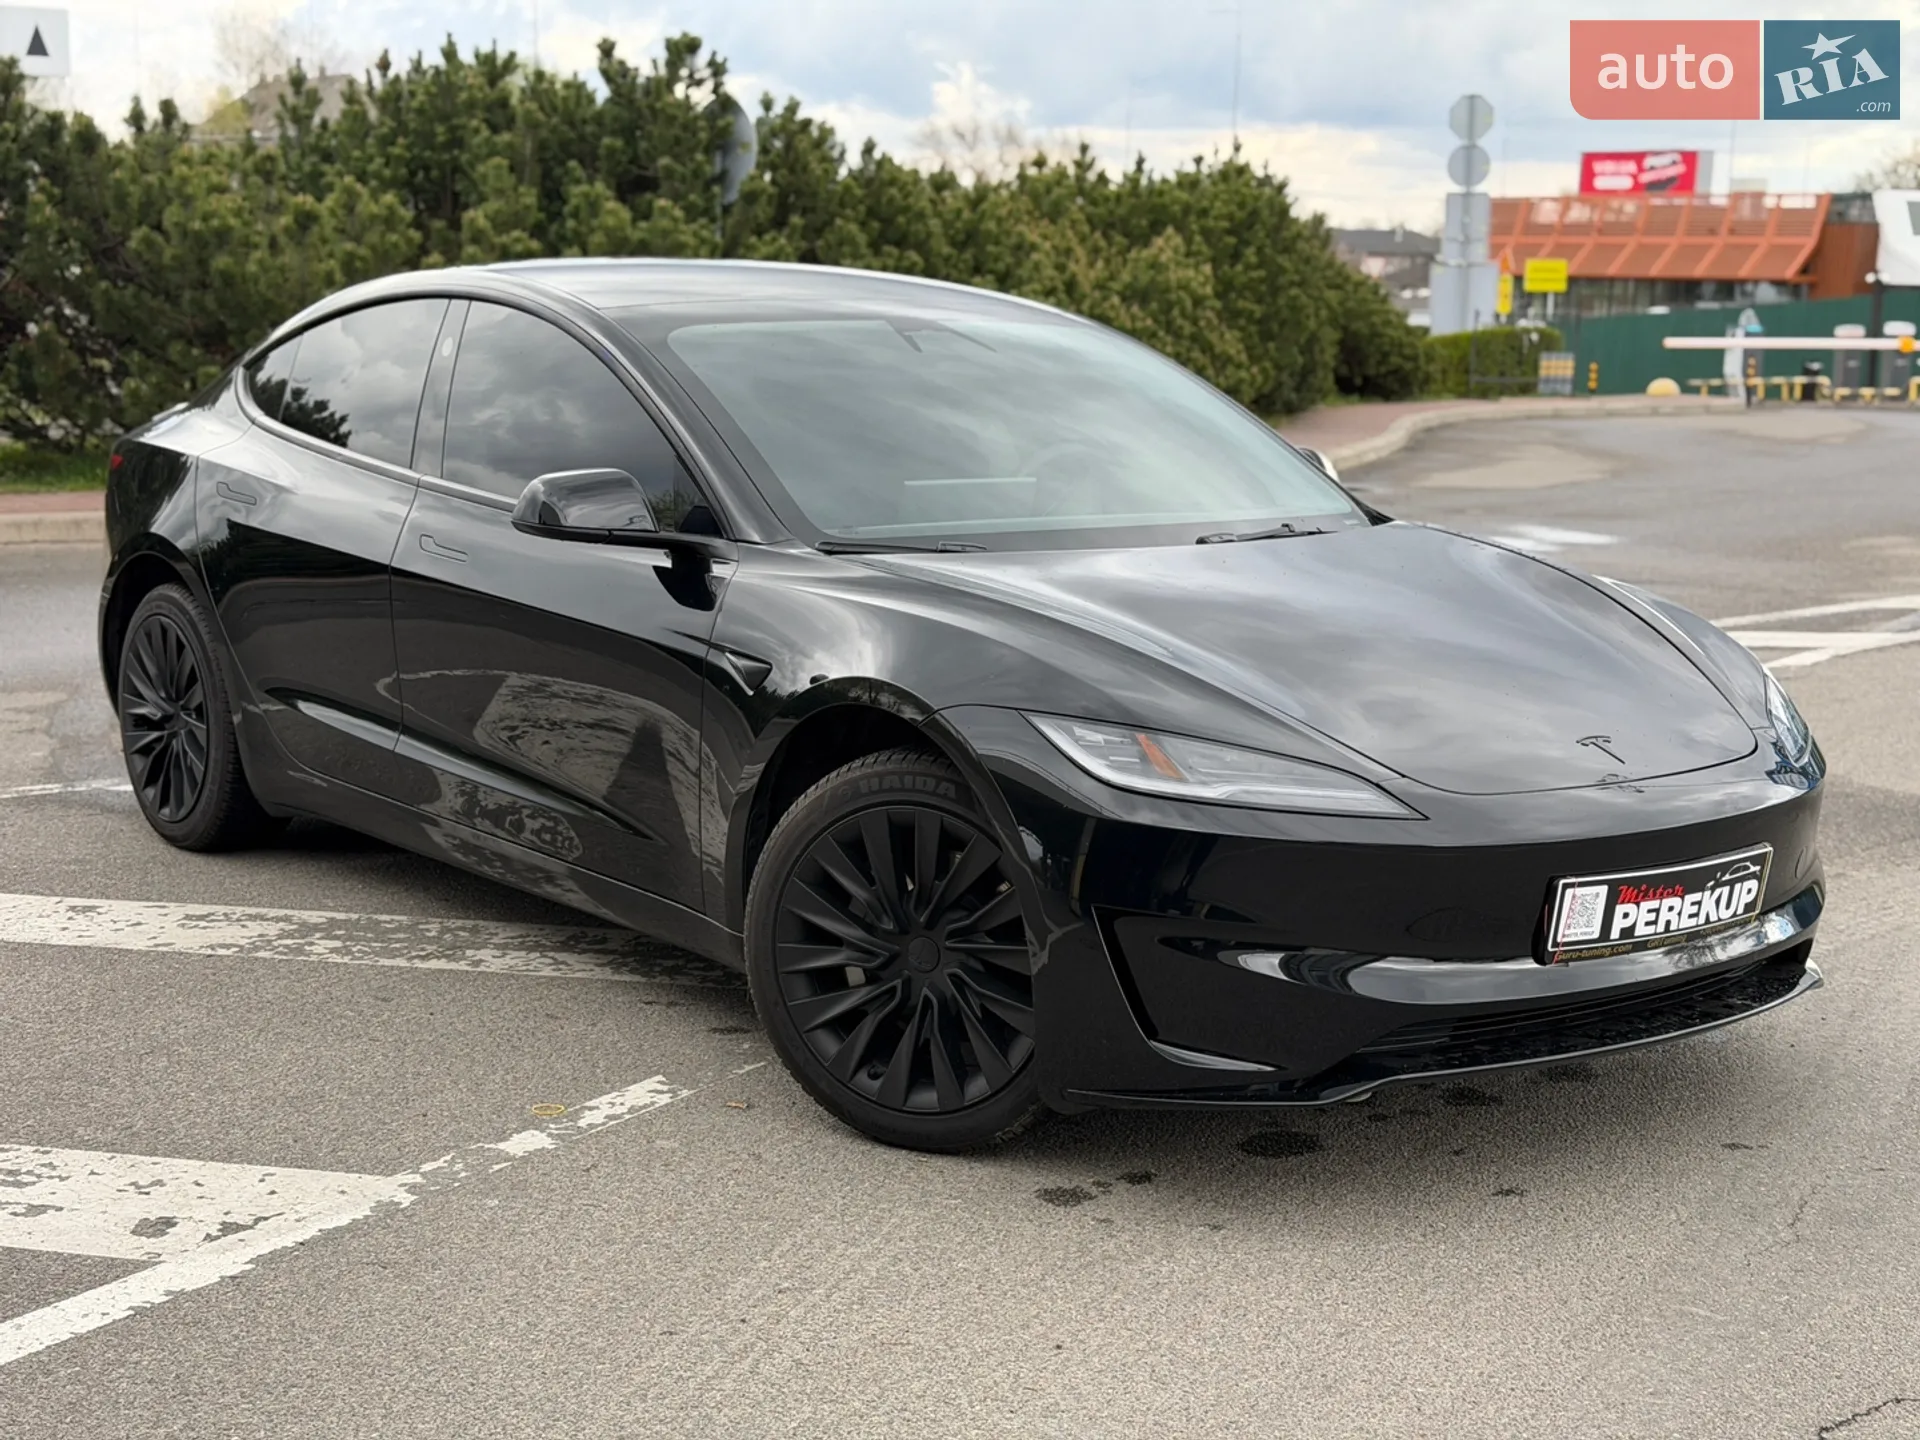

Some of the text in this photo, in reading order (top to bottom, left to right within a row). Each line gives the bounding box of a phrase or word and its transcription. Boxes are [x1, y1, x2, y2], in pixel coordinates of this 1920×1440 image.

[858, 774, 957, 799] HAIDA
[1617, 883, 1685, 904] Mister
[1610, 878, 1759, 940] PEREKUP
